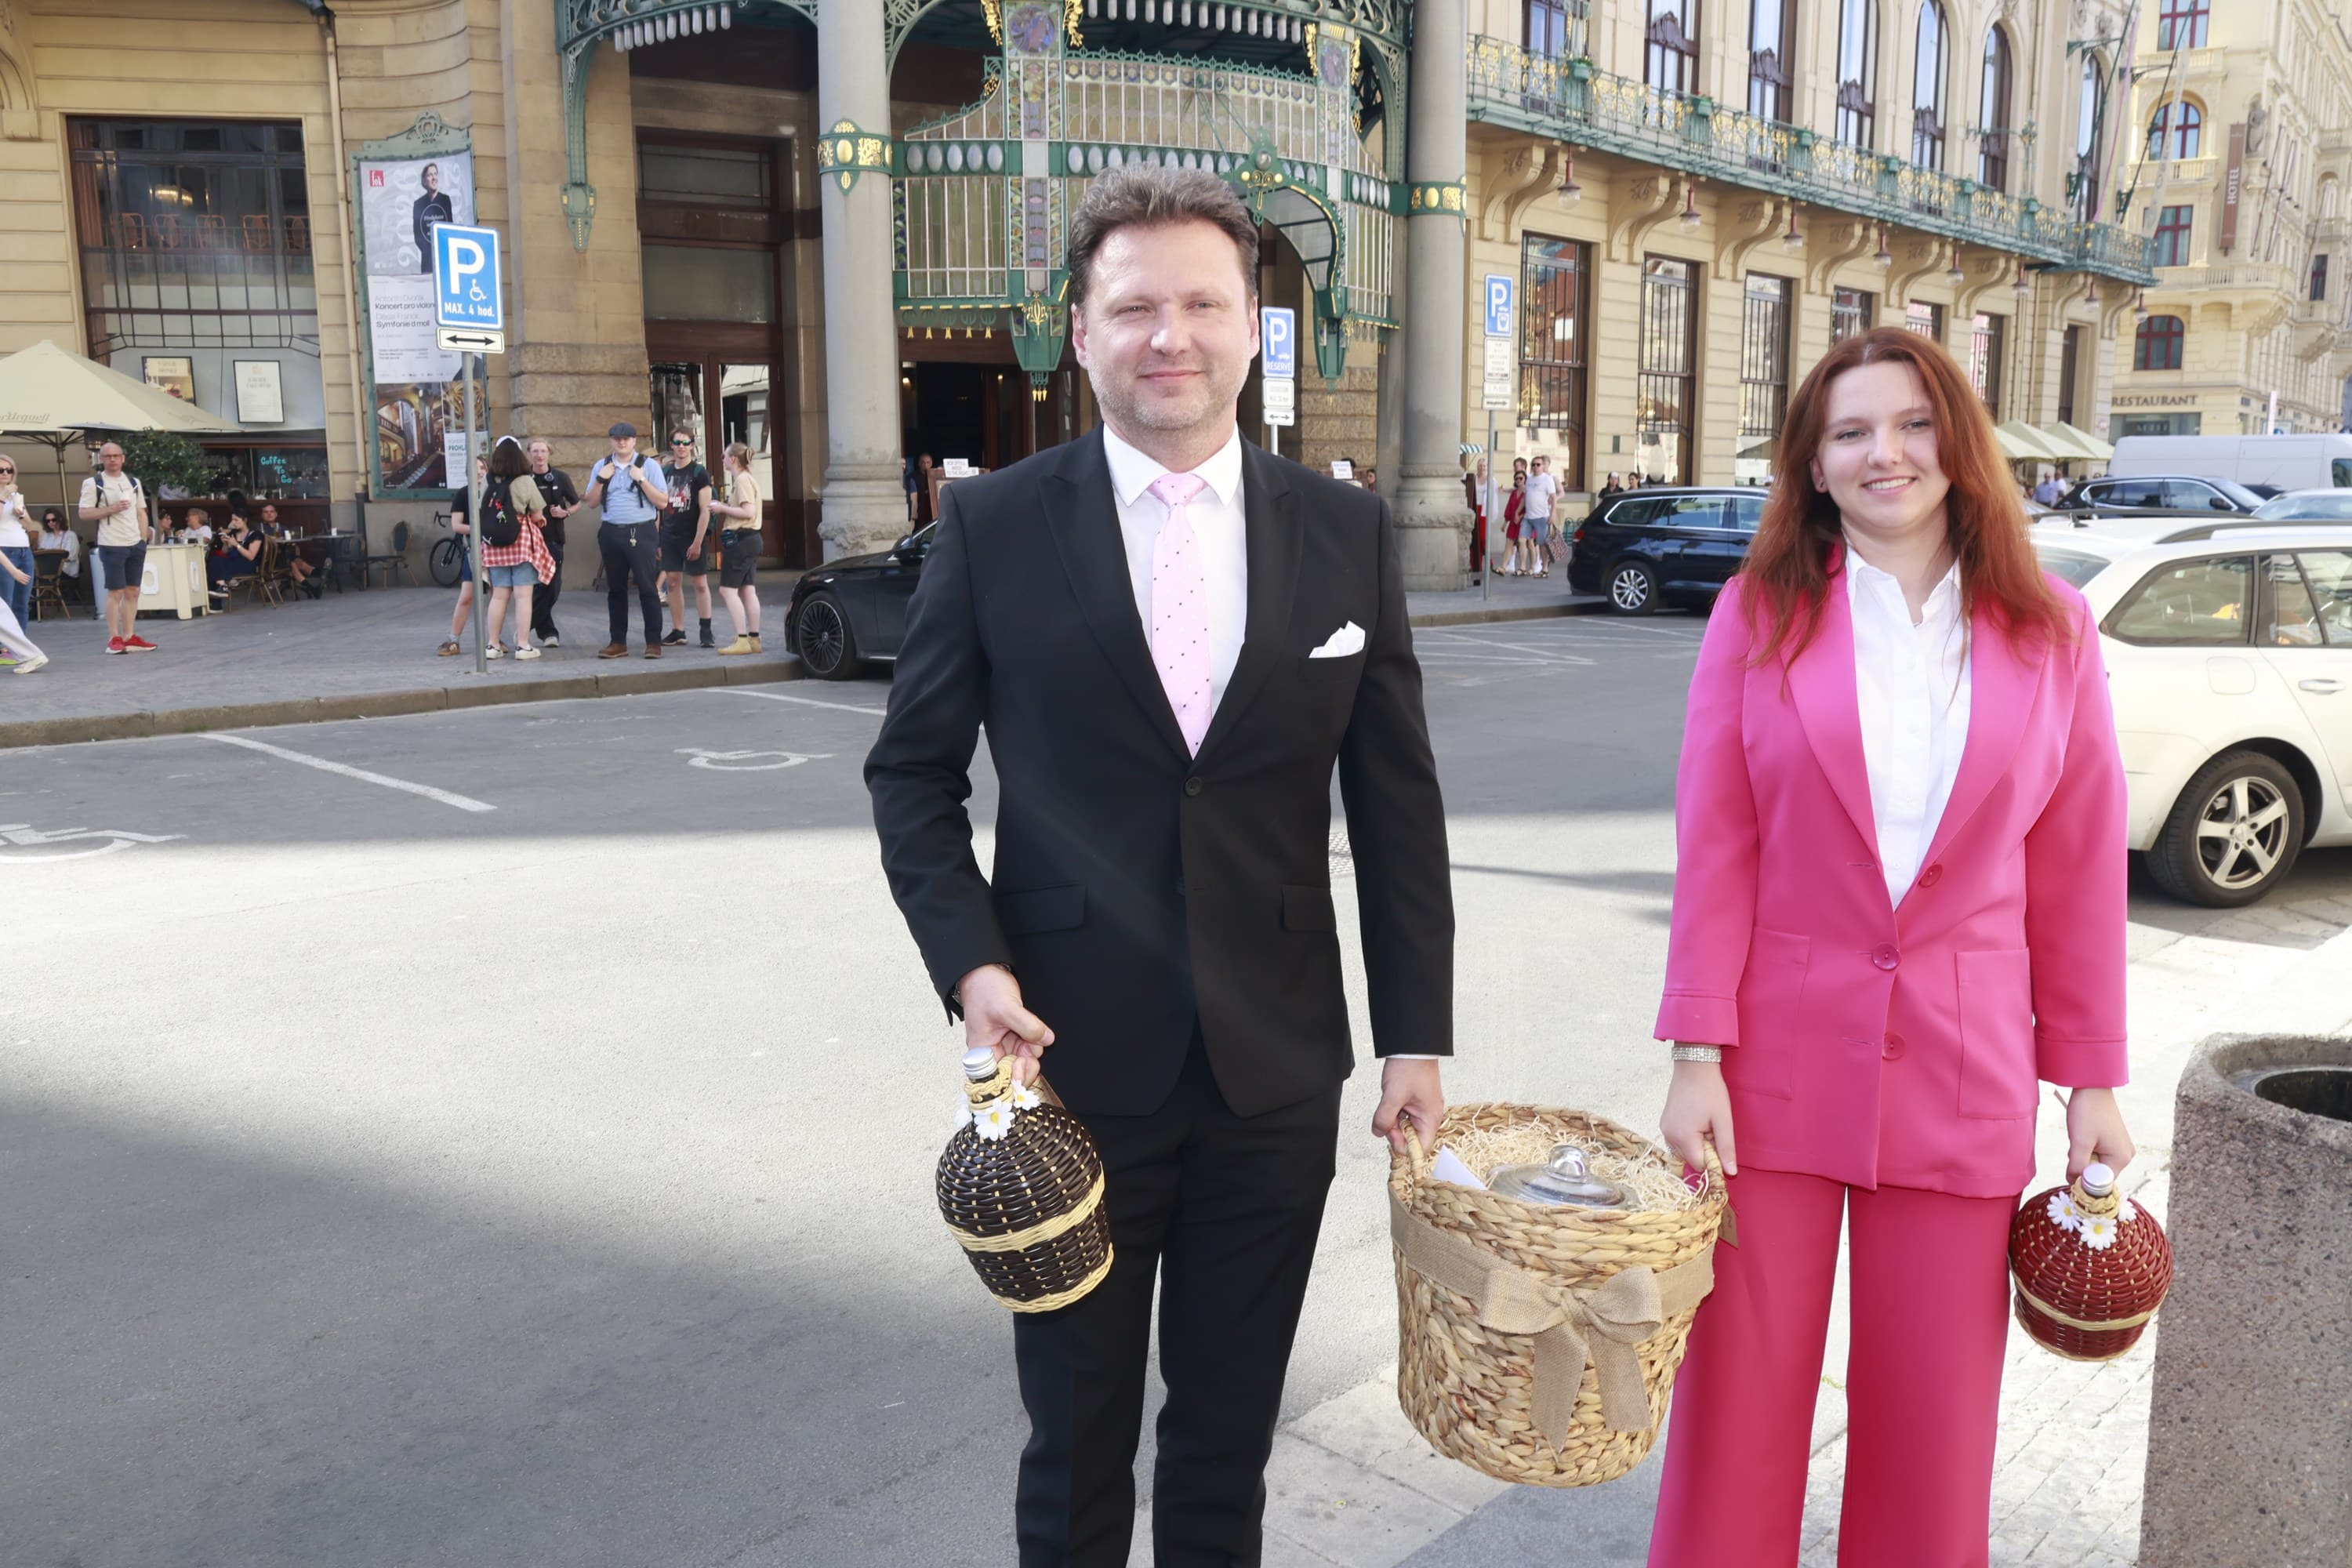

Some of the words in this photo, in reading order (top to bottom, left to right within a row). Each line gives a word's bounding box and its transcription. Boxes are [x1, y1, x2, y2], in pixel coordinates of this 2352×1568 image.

[2227, 167, 2239, 205] HOTEL
[448, 237, 485, 294] P
[1491, 282, 1507, 318] P
[445, 302, 465, 314] MAX.
[469, 304, 474, 315] 4
[477, 306, 495, 317] hod.
[376, 321, 411, 329] Symfonie
[1269, 317, 1287, 356] P
[2111, 394, 2198, 406] RESTAURANT
[260, 456, 287, 465] Coffee
[274, 465, 285, 474] To
[281, 474, 292, 483] Go
